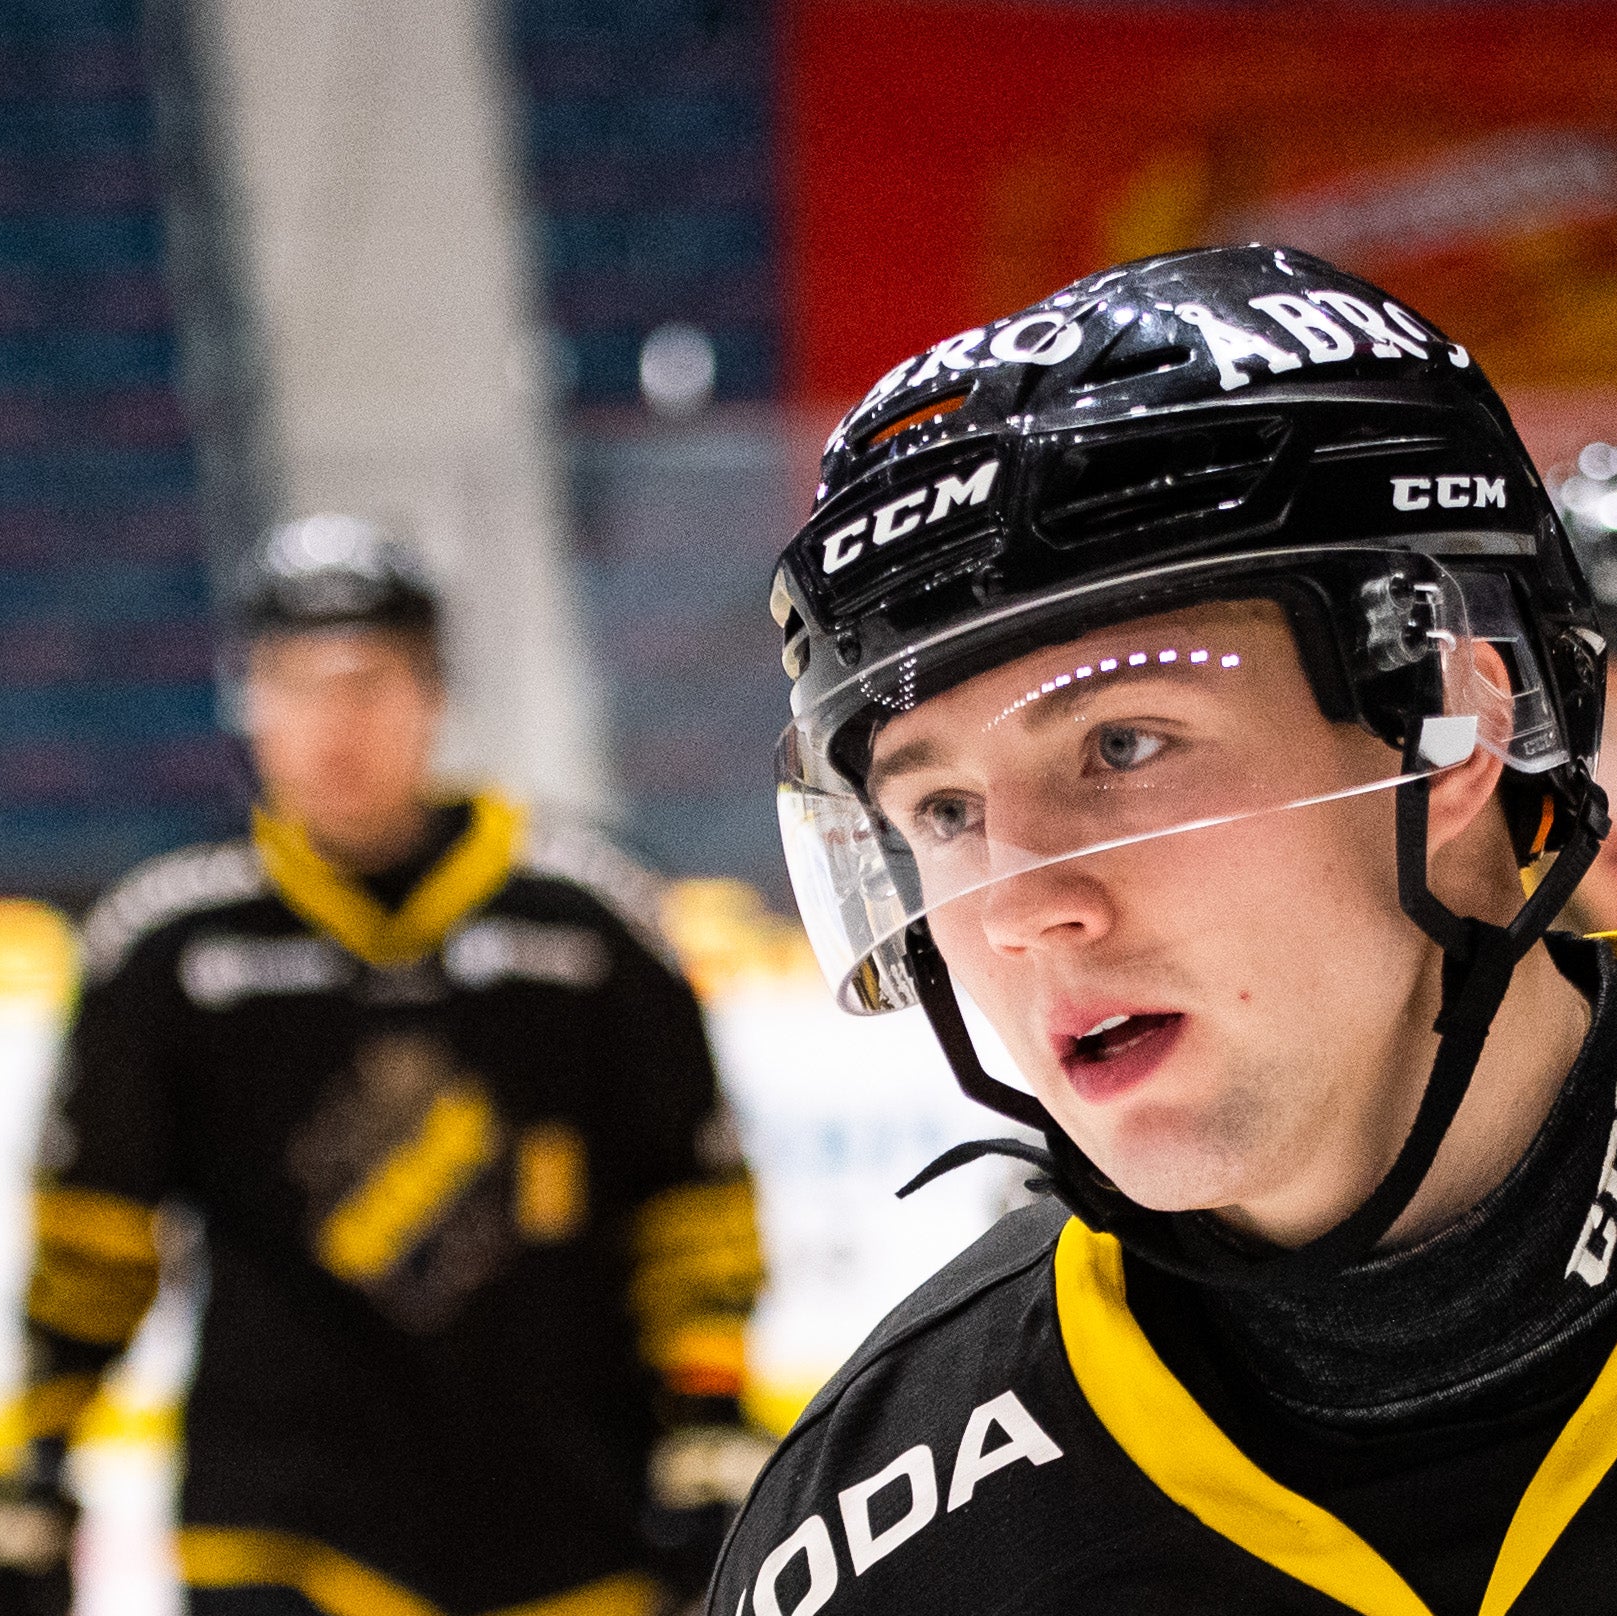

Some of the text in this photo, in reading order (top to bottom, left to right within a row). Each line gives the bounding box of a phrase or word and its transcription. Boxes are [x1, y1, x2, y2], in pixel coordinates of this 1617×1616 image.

[824, 309, 1083, 454] BRO
[821, 458, 999, 574] CCM
[1392, 475, 1508, 511] CCM
